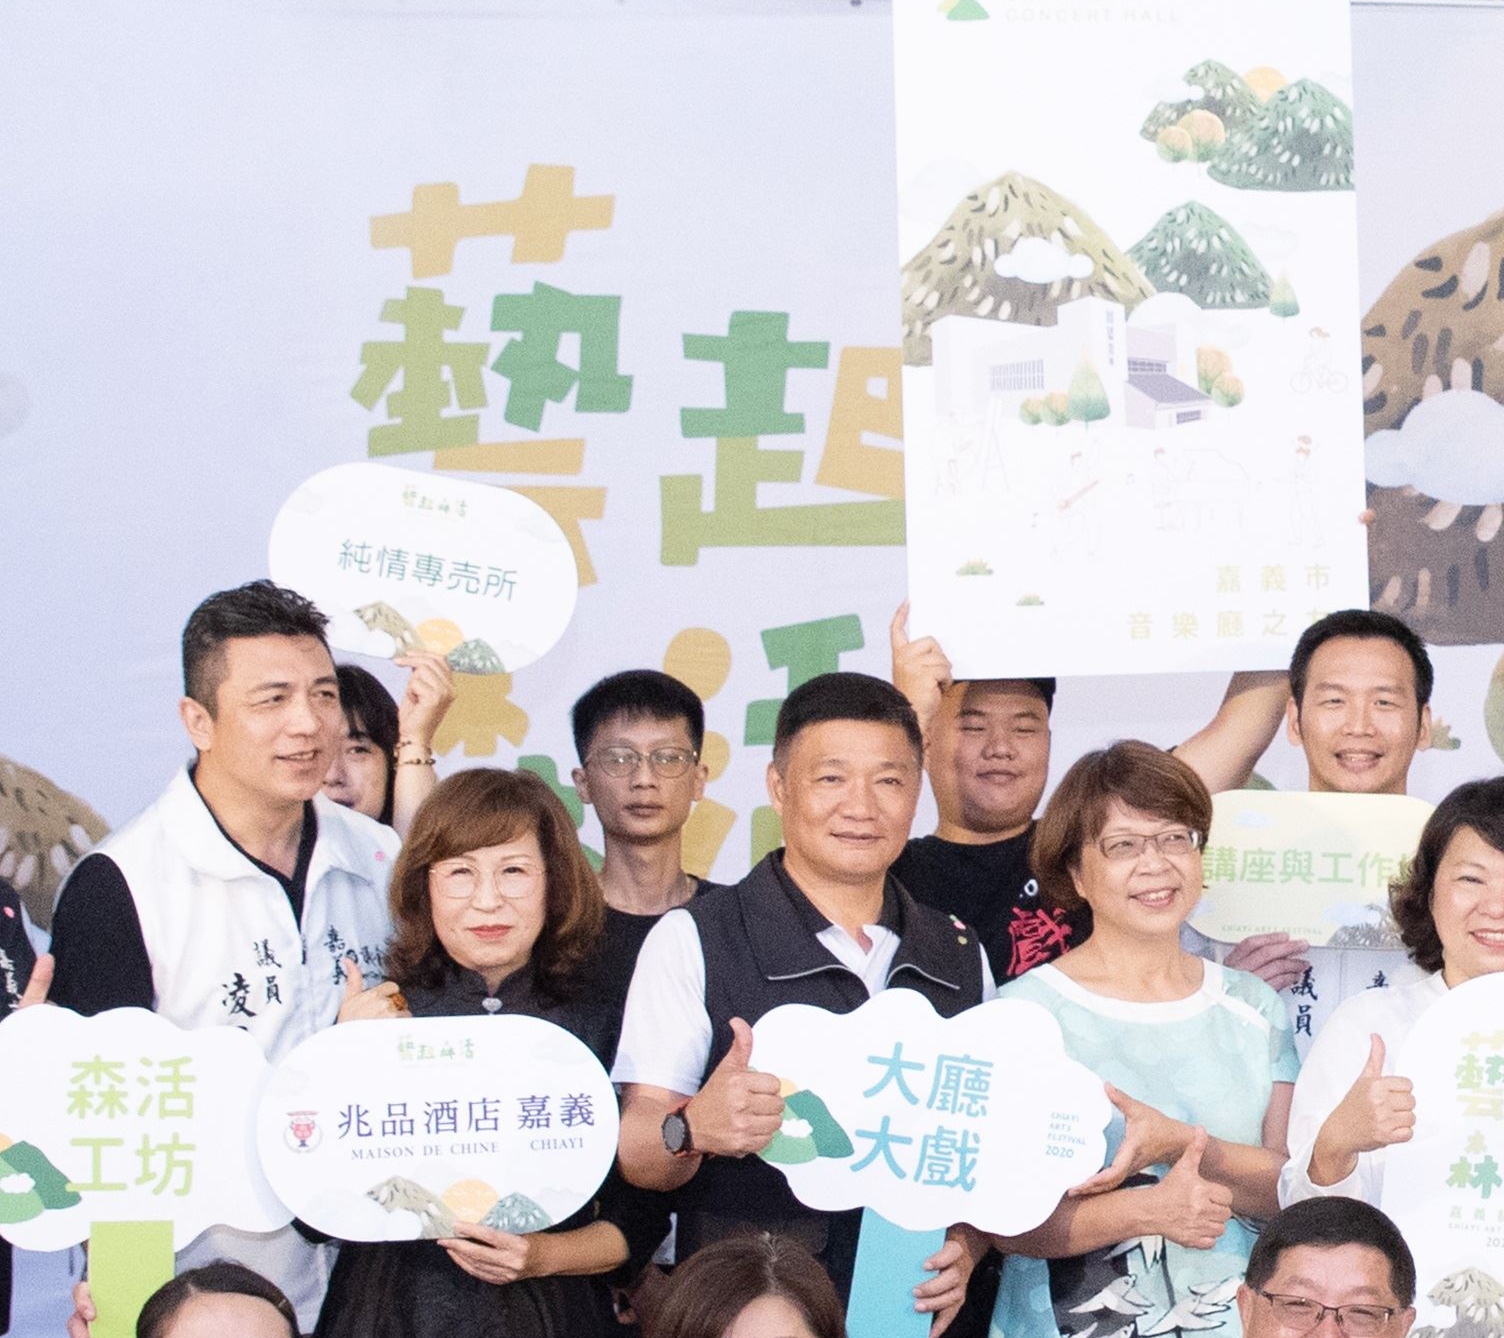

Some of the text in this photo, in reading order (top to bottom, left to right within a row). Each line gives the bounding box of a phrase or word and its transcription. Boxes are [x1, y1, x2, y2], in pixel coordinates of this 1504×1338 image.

[338, 539, 518, 601] 純情專売所
[1215, 564, 1330, 593] 嘉義市
[254, 939, 283, 1005] 議員
[67, 1054, 197, 1119] 森活
[862, 1042, 994, 1119] 大廳
[337, 1092, 596, 1141] 兆品酒店 嘉義
[65, 1132, 196, 1197] 工坊
[351, 1136, 585, 1161] MAISON DE CHINE CHIAYI
[850, 1115, 983, 1193] 大戲
[1045, 1145, 1075, 1159] 2020
